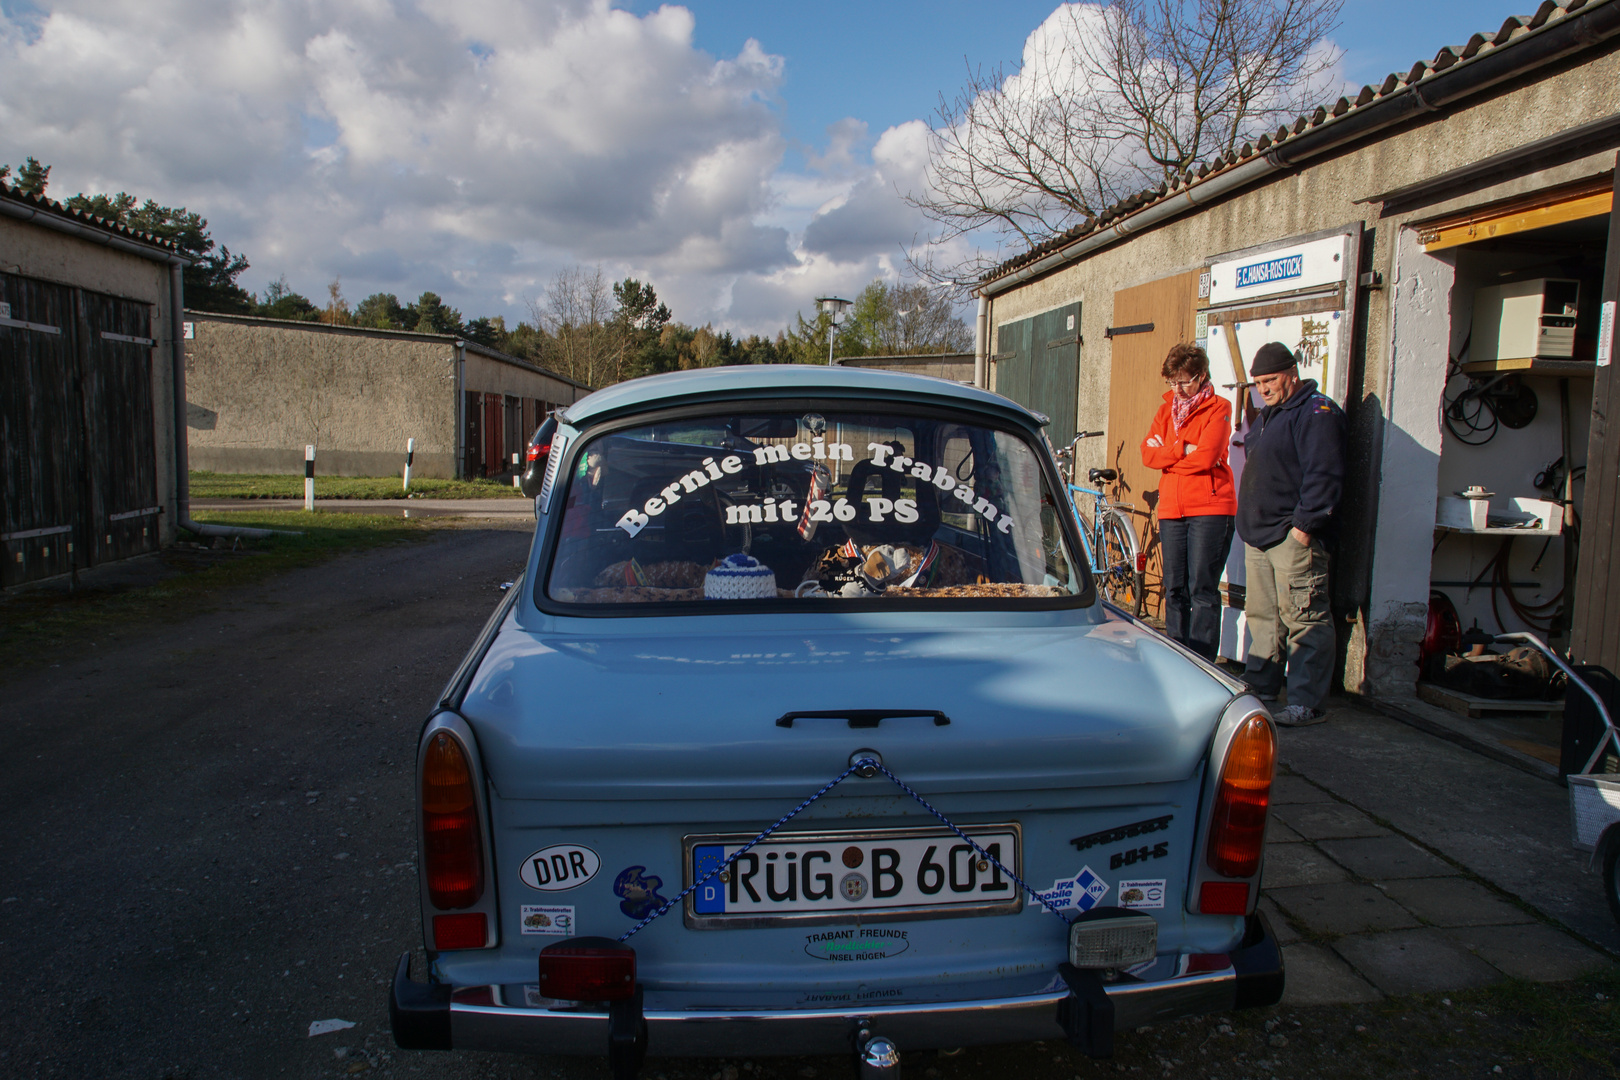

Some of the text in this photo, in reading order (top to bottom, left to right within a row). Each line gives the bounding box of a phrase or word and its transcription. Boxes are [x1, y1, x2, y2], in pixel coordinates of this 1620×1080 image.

[614, 436, 1016, 539] Bernie mein Trabant
[725, 497, 919, 524] mit 26 PS
[532, 850, 589, 886] DDR
[871, 847, 903, 899] B
[916, 843, 1009, 895] 601
[1056, 881, 1074, 890] IFA
[1090, 885, 1102, 893] IFA
[704, 886, 715, 901] D
[806, 929, 908, 943] TRABANT FREUNDE
[829, 952, 886, 961] INSEL RÜGEN
